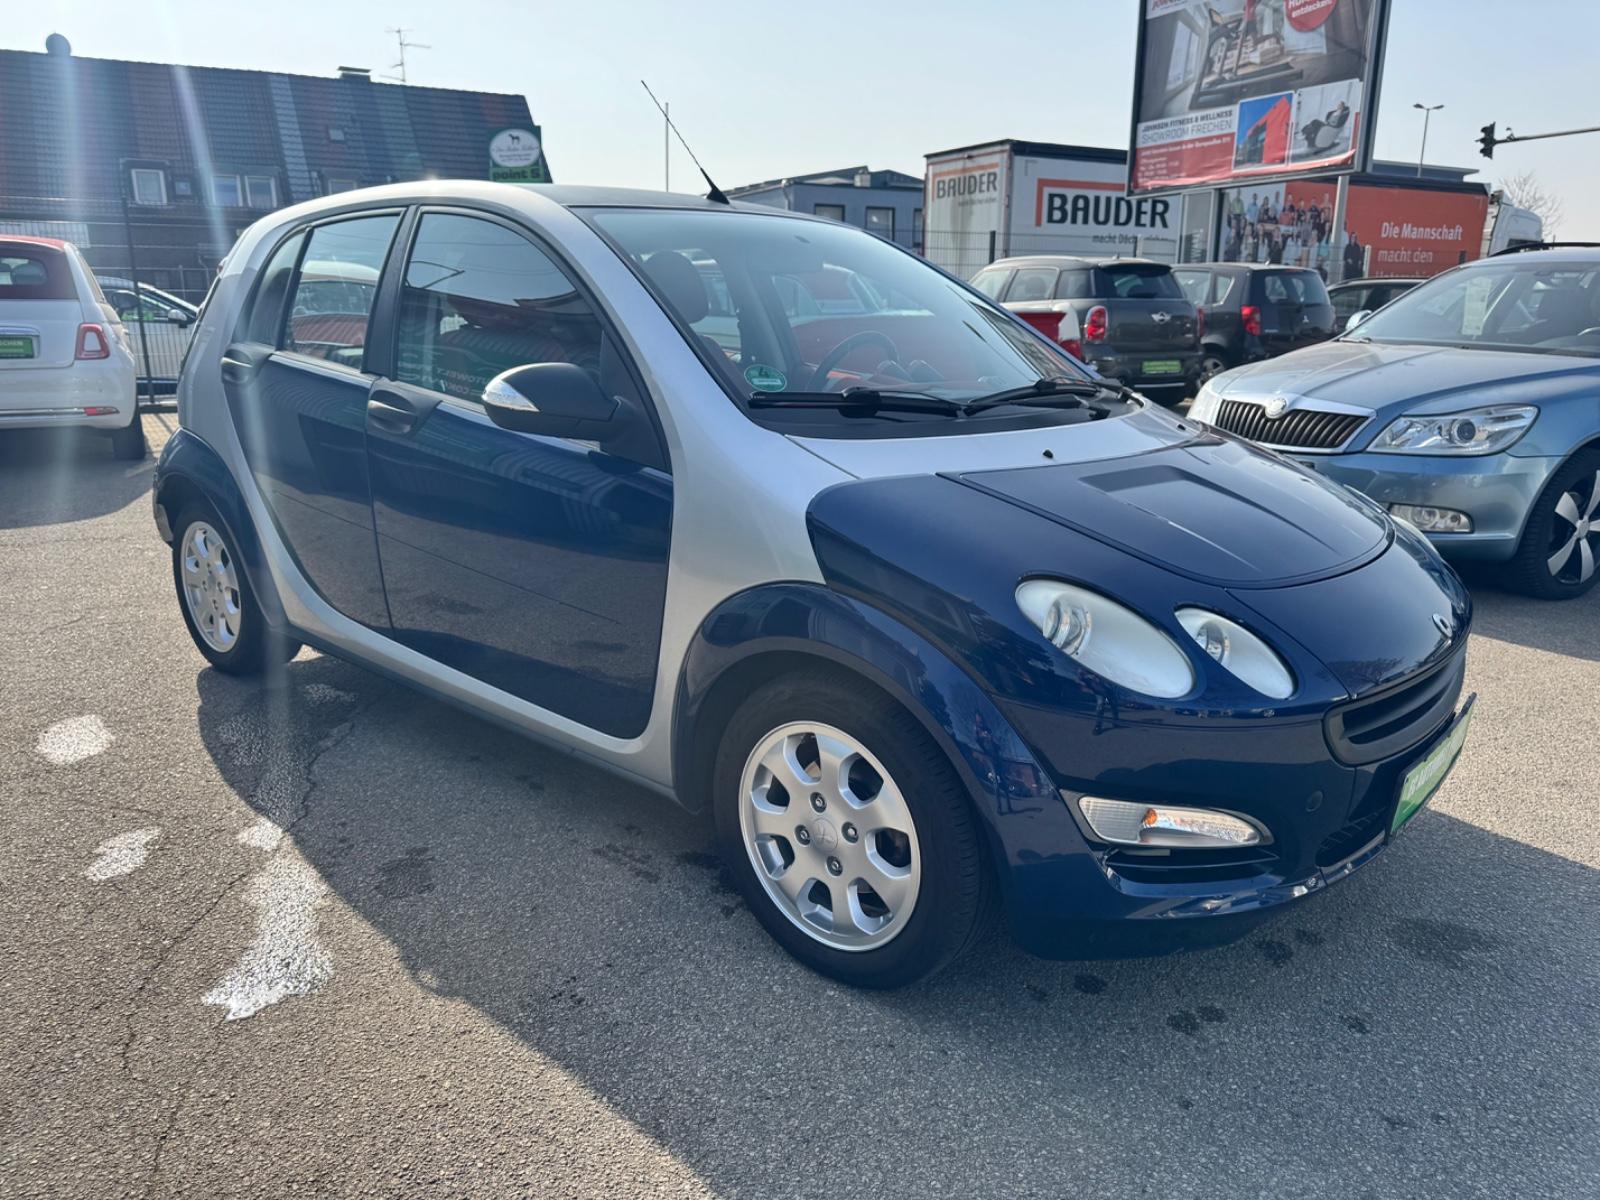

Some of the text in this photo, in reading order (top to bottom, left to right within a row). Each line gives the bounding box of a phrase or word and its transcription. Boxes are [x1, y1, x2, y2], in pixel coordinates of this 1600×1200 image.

[1170, 116, 1193, 127] FITNESS
[1200, 110, 1233, 122] WELLNESS
[1141, 119, 1232, 144] SHOWROOM FRECHEN
[492, 168, 541, 180] point S
[936, 171, 998, 200] BAUDER
[1047, 193, 1170, 229] BAUDER
[1092, 233, 1117, 244] macht
[1381, 222, 1463, 241] Die Mannschaft
[1377, 248, 1433, 263] macht den
